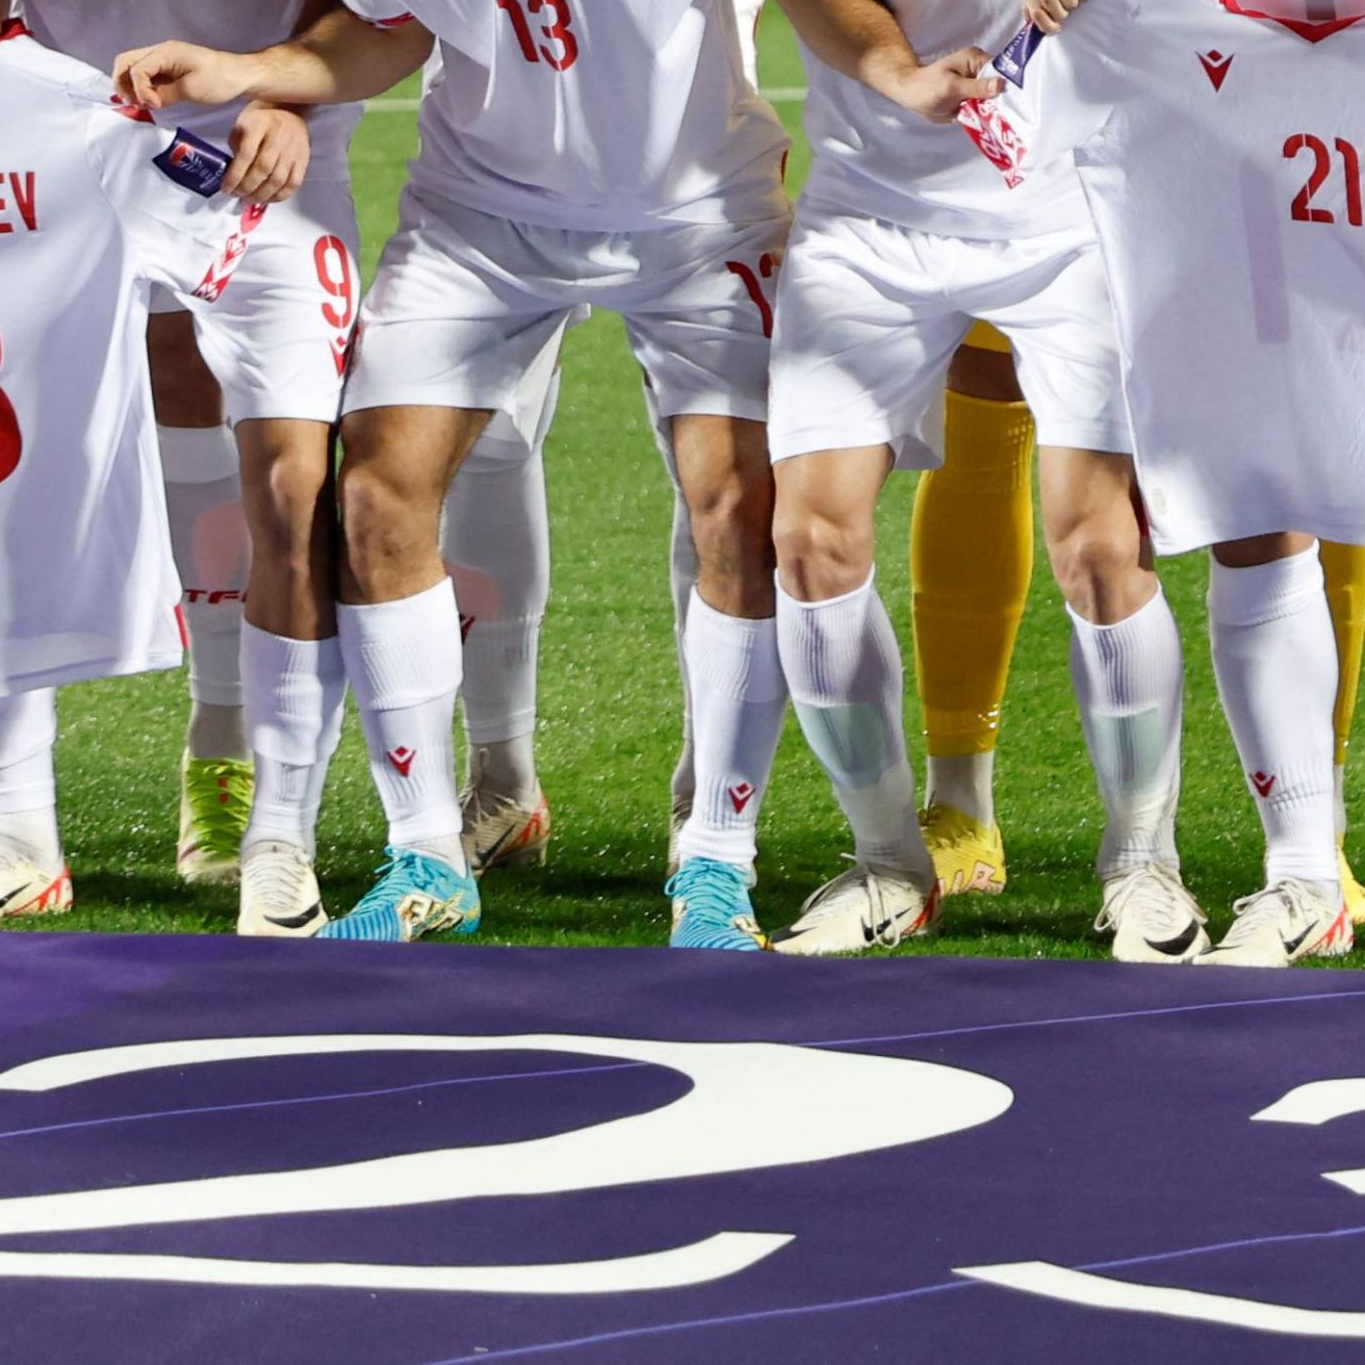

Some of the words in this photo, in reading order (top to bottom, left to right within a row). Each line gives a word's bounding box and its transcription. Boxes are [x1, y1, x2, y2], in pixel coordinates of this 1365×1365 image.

[1283, 133, 1364, 227] 21
[313, 234, 353, 330] 9
[183, 589, 248, 605] TF
